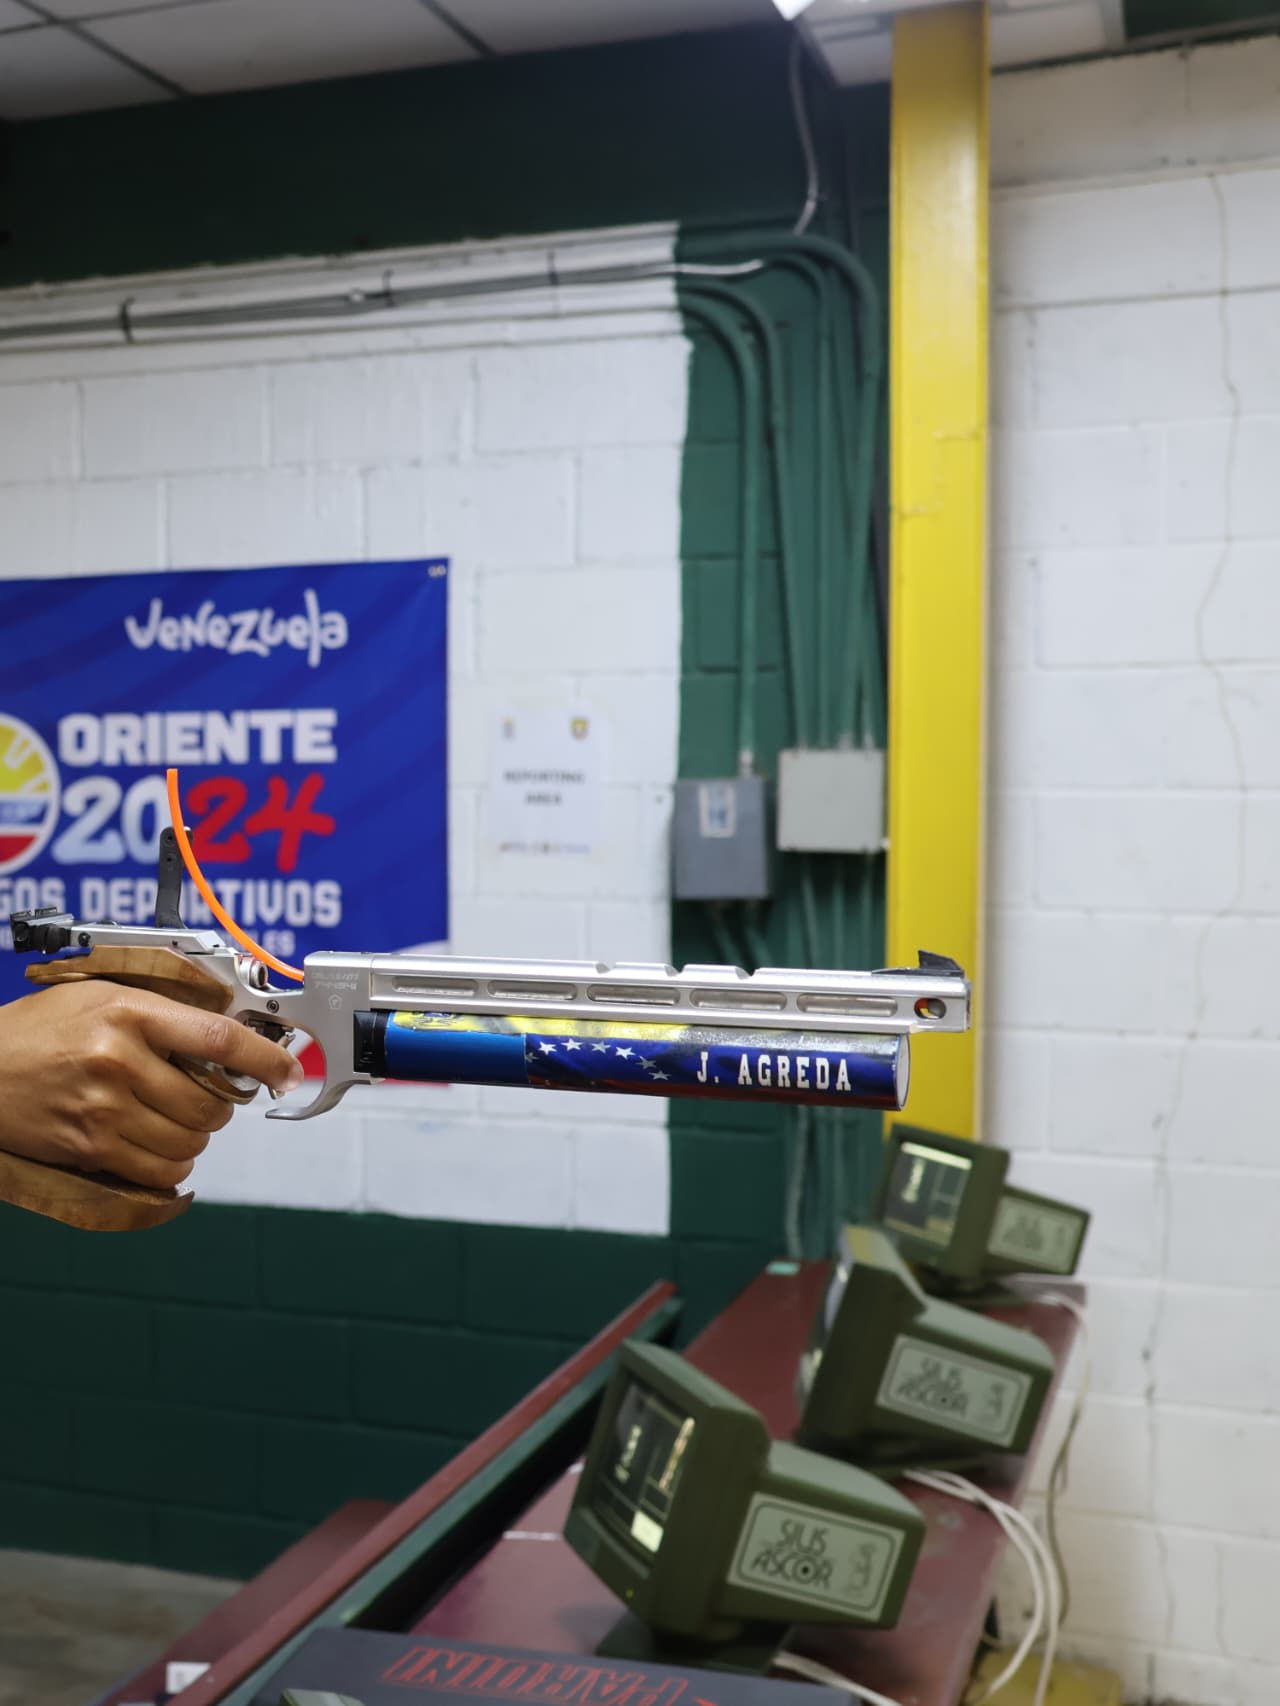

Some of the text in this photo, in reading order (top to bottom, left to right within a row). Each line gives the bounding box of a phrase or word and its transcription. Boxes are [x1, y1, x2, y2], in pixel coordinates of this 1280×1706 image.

[57, 708, 338, 767] ORIENTE
[50, 771, 337, 874] 2024
[696, 1051, 852, 1092] J. AGREDA
